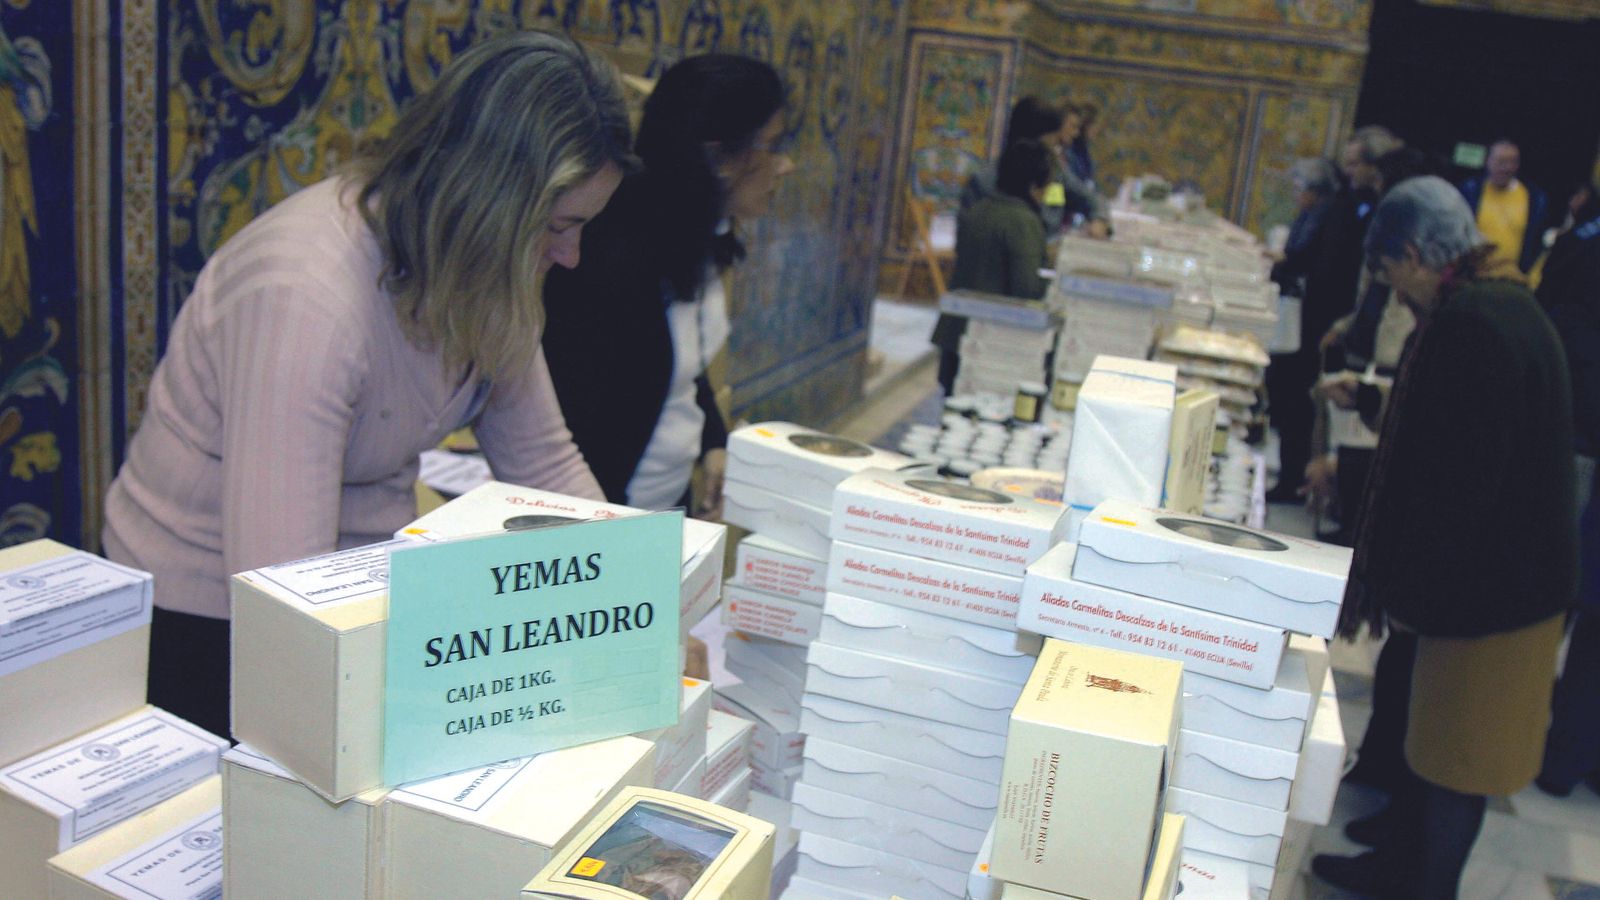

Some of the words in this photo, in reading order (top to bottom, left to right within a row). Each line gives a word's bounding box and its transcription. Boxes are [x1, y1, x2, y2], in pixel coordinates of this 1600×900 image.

[872, 510, 908, 526] Carmelitas
[910, 517, 943, 533] Descalzas
[945, 523, 954, 534] de
[956, 526, 962, 536] la
[1000, 534, 1031, 549] Trinidad
[305, 583, 352, 597] LEANDRO
[352, 579, 374, 587] SAN
[490, 553, 602, 595] YEMAS
[844, 559, 868, 572] Aliadas
[870, 564, 906, 579] Carmelitas
[907, 571, 941, 587] Descalzas
[943, 578, 951, 589] de
[953, 580, 960, 591] la
[424, 628, 492, 667] SAN
[502, 602, 654, 653] LEANDRO
[1040, 592, 1070, 608] Aliadas
[1072, 600, 1113, 619] Carmelitas
[1115, 610, 1155, 629] Descalzas
[1157, 620, 1167, 632] de
[1170, 622, 1177, 634] la
[1223, 635, 1259, 653] Trinidad
[1127, 633, 1143, 644] 954
[1144, 637, 1154, 647] 83
[1156, 640, 1166, 650] 12
[1168, 643, 1177, 653] 61
[447, 683, 487, 704] CAJA
[492, 677, 514, 694] DE
[519, 670, 556, 689] 1KG.
[445, 715, 486, 736] CAJA
[491, 709, 513, 726] DE
[539, 699, 566, 716] KG.
[68, 757, 82, 767] DE
[480, 768, 496, 778] SAN
[454, 778, 484, 803] LEANDRO
[1044, 753, 1060, 808] BIZCOCHO
[1041, 810, 1051, 824] DE
[1034, 826, 1048, 864] FRUTAS
[130, 857, 167, 877] YEMAS
[167, 849, 181, 859] DE
